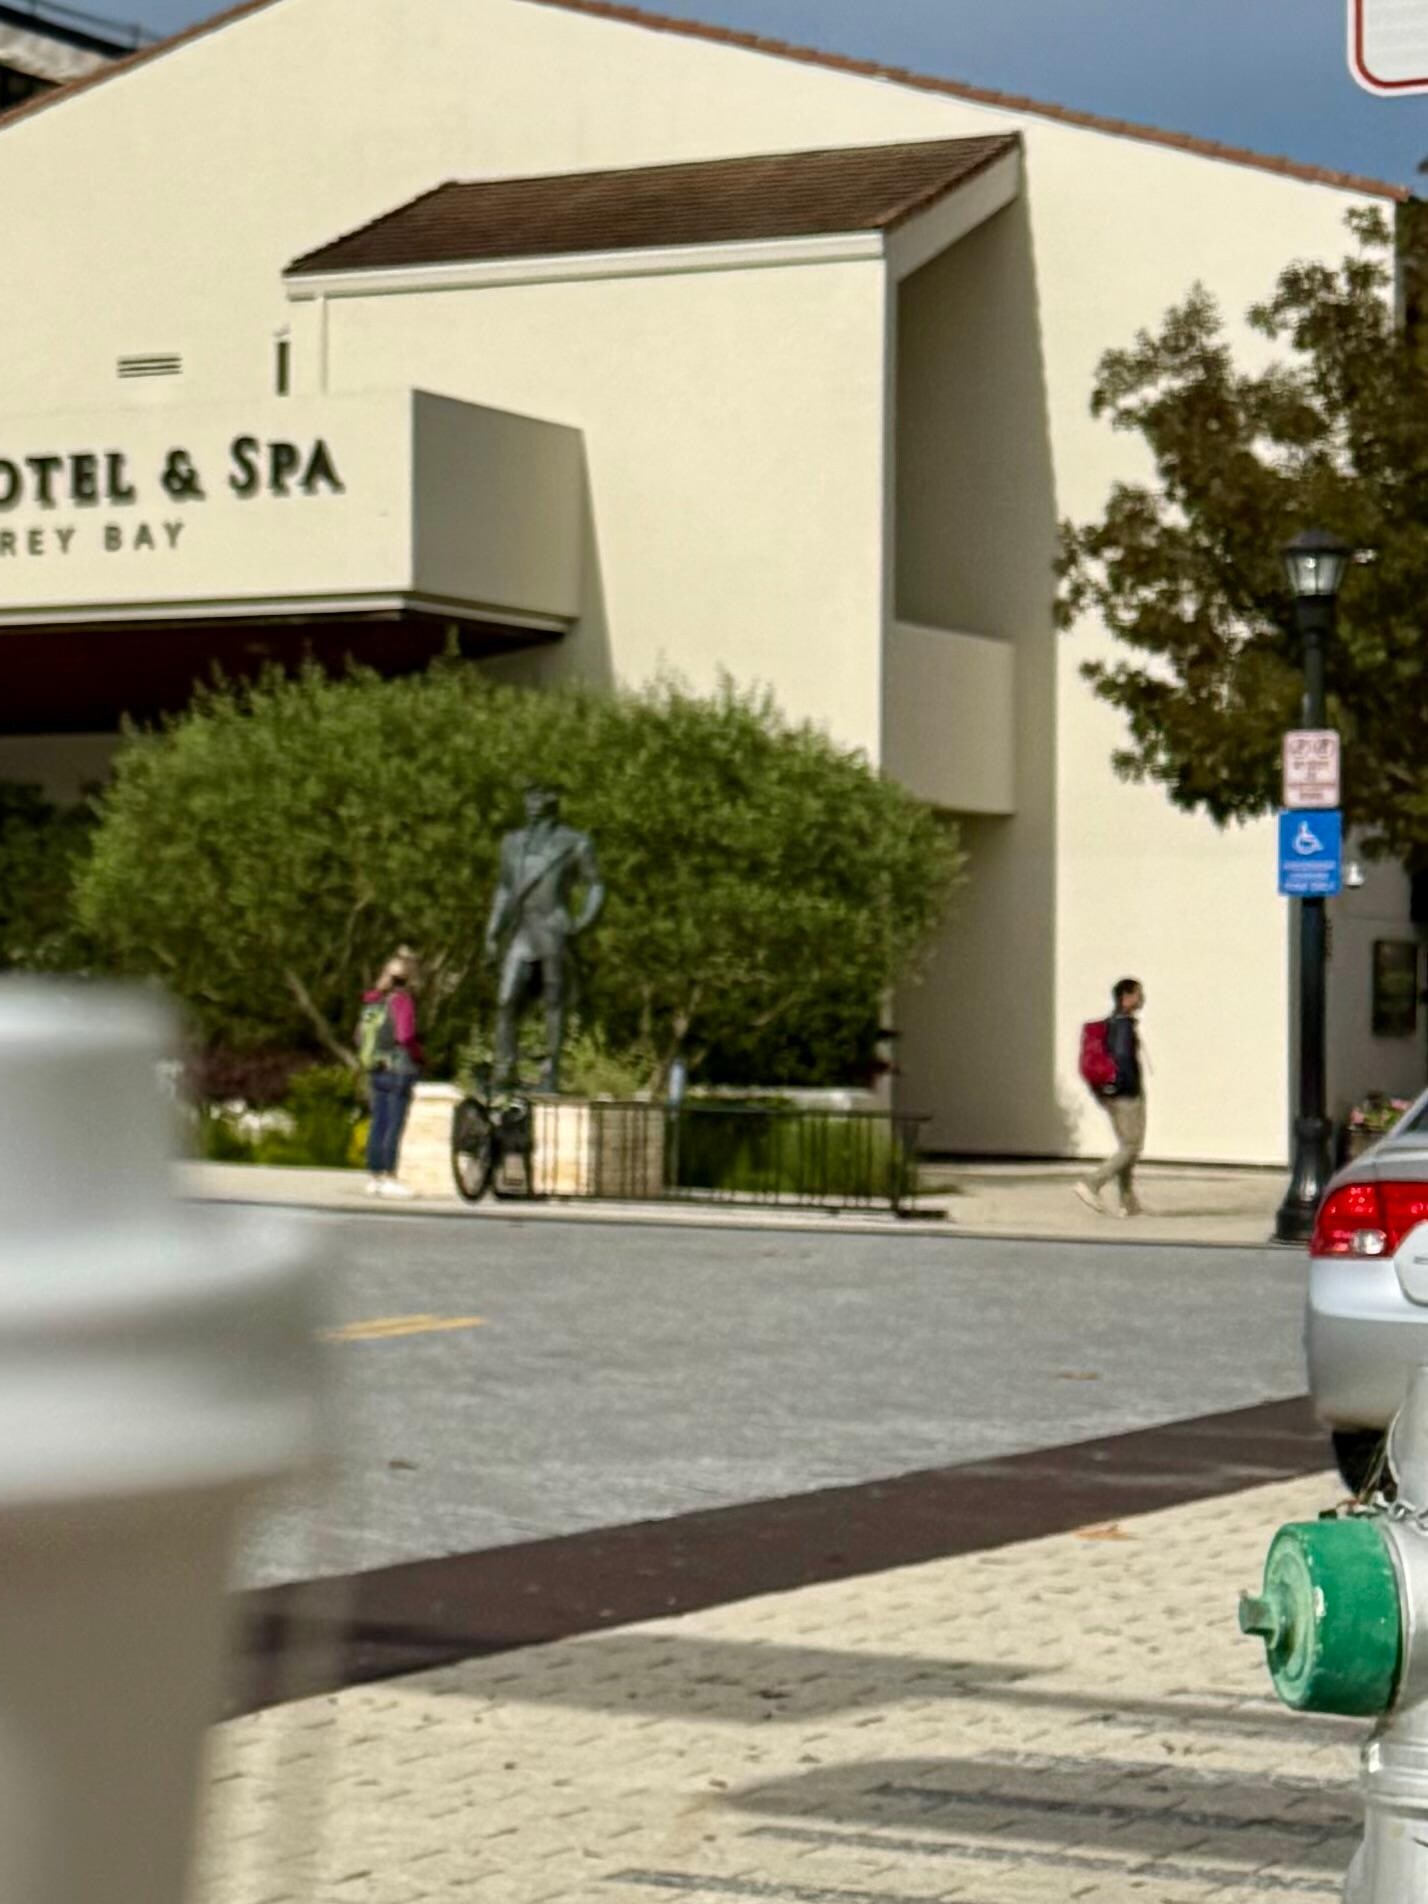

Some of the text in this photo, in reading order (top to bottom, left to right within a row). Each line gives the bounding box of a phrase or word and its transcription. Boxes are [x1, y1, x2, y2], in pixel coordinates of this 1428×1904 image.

[159, 448, 206, 502] &
[229, 434, 345, 498] SPA
[104, 522, 184, 552] BAY
